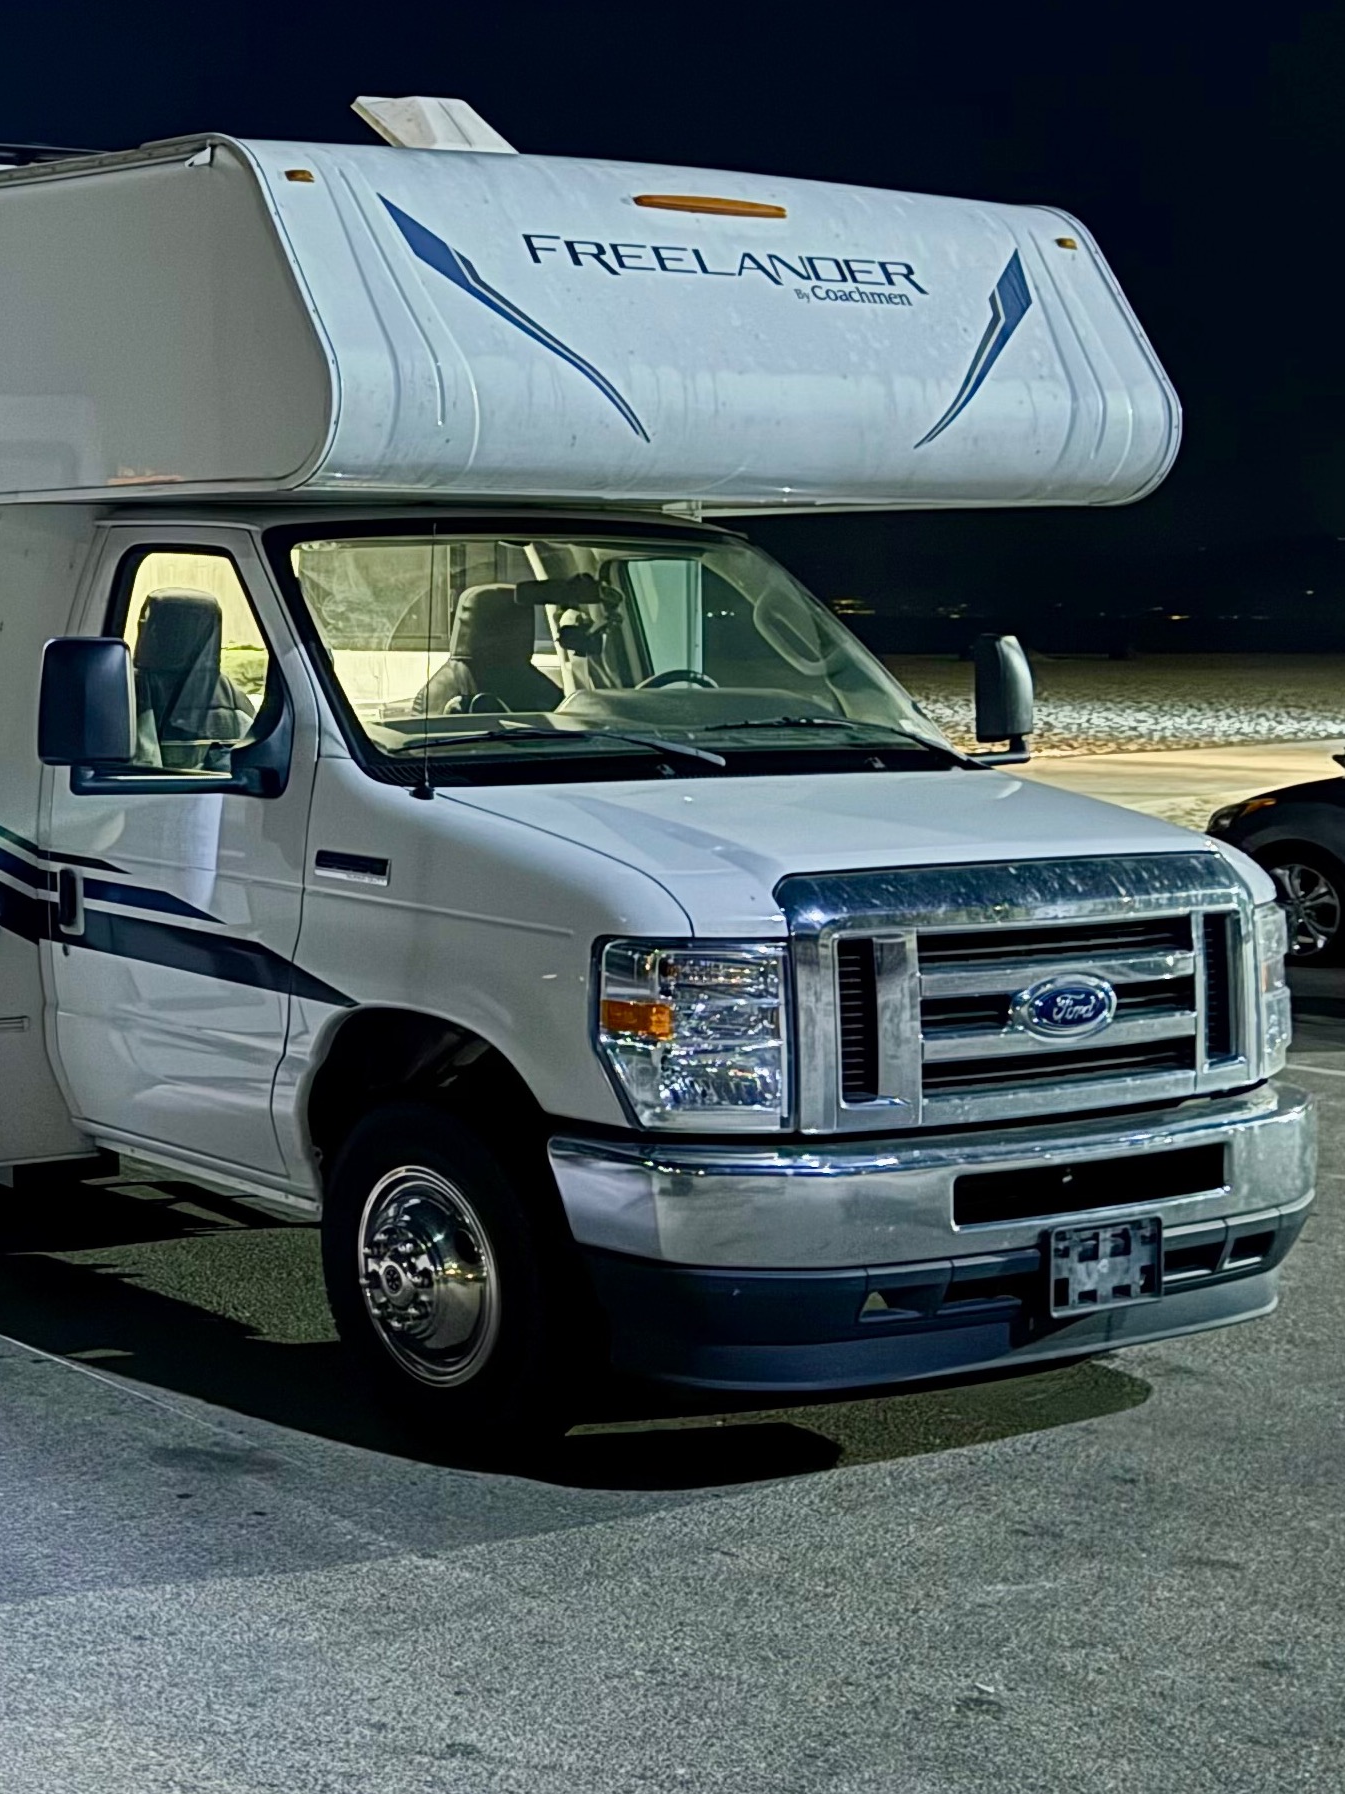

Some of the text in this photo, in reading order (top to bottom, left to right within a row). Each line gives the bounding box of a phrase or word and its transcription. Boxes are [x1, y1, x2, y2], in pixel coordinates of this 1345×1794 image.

[522, 233, 929, 295] FREELANDER
[795, 285, 913, 307] By Coachmen
[1052, 994, 1096, 1022] Ford
